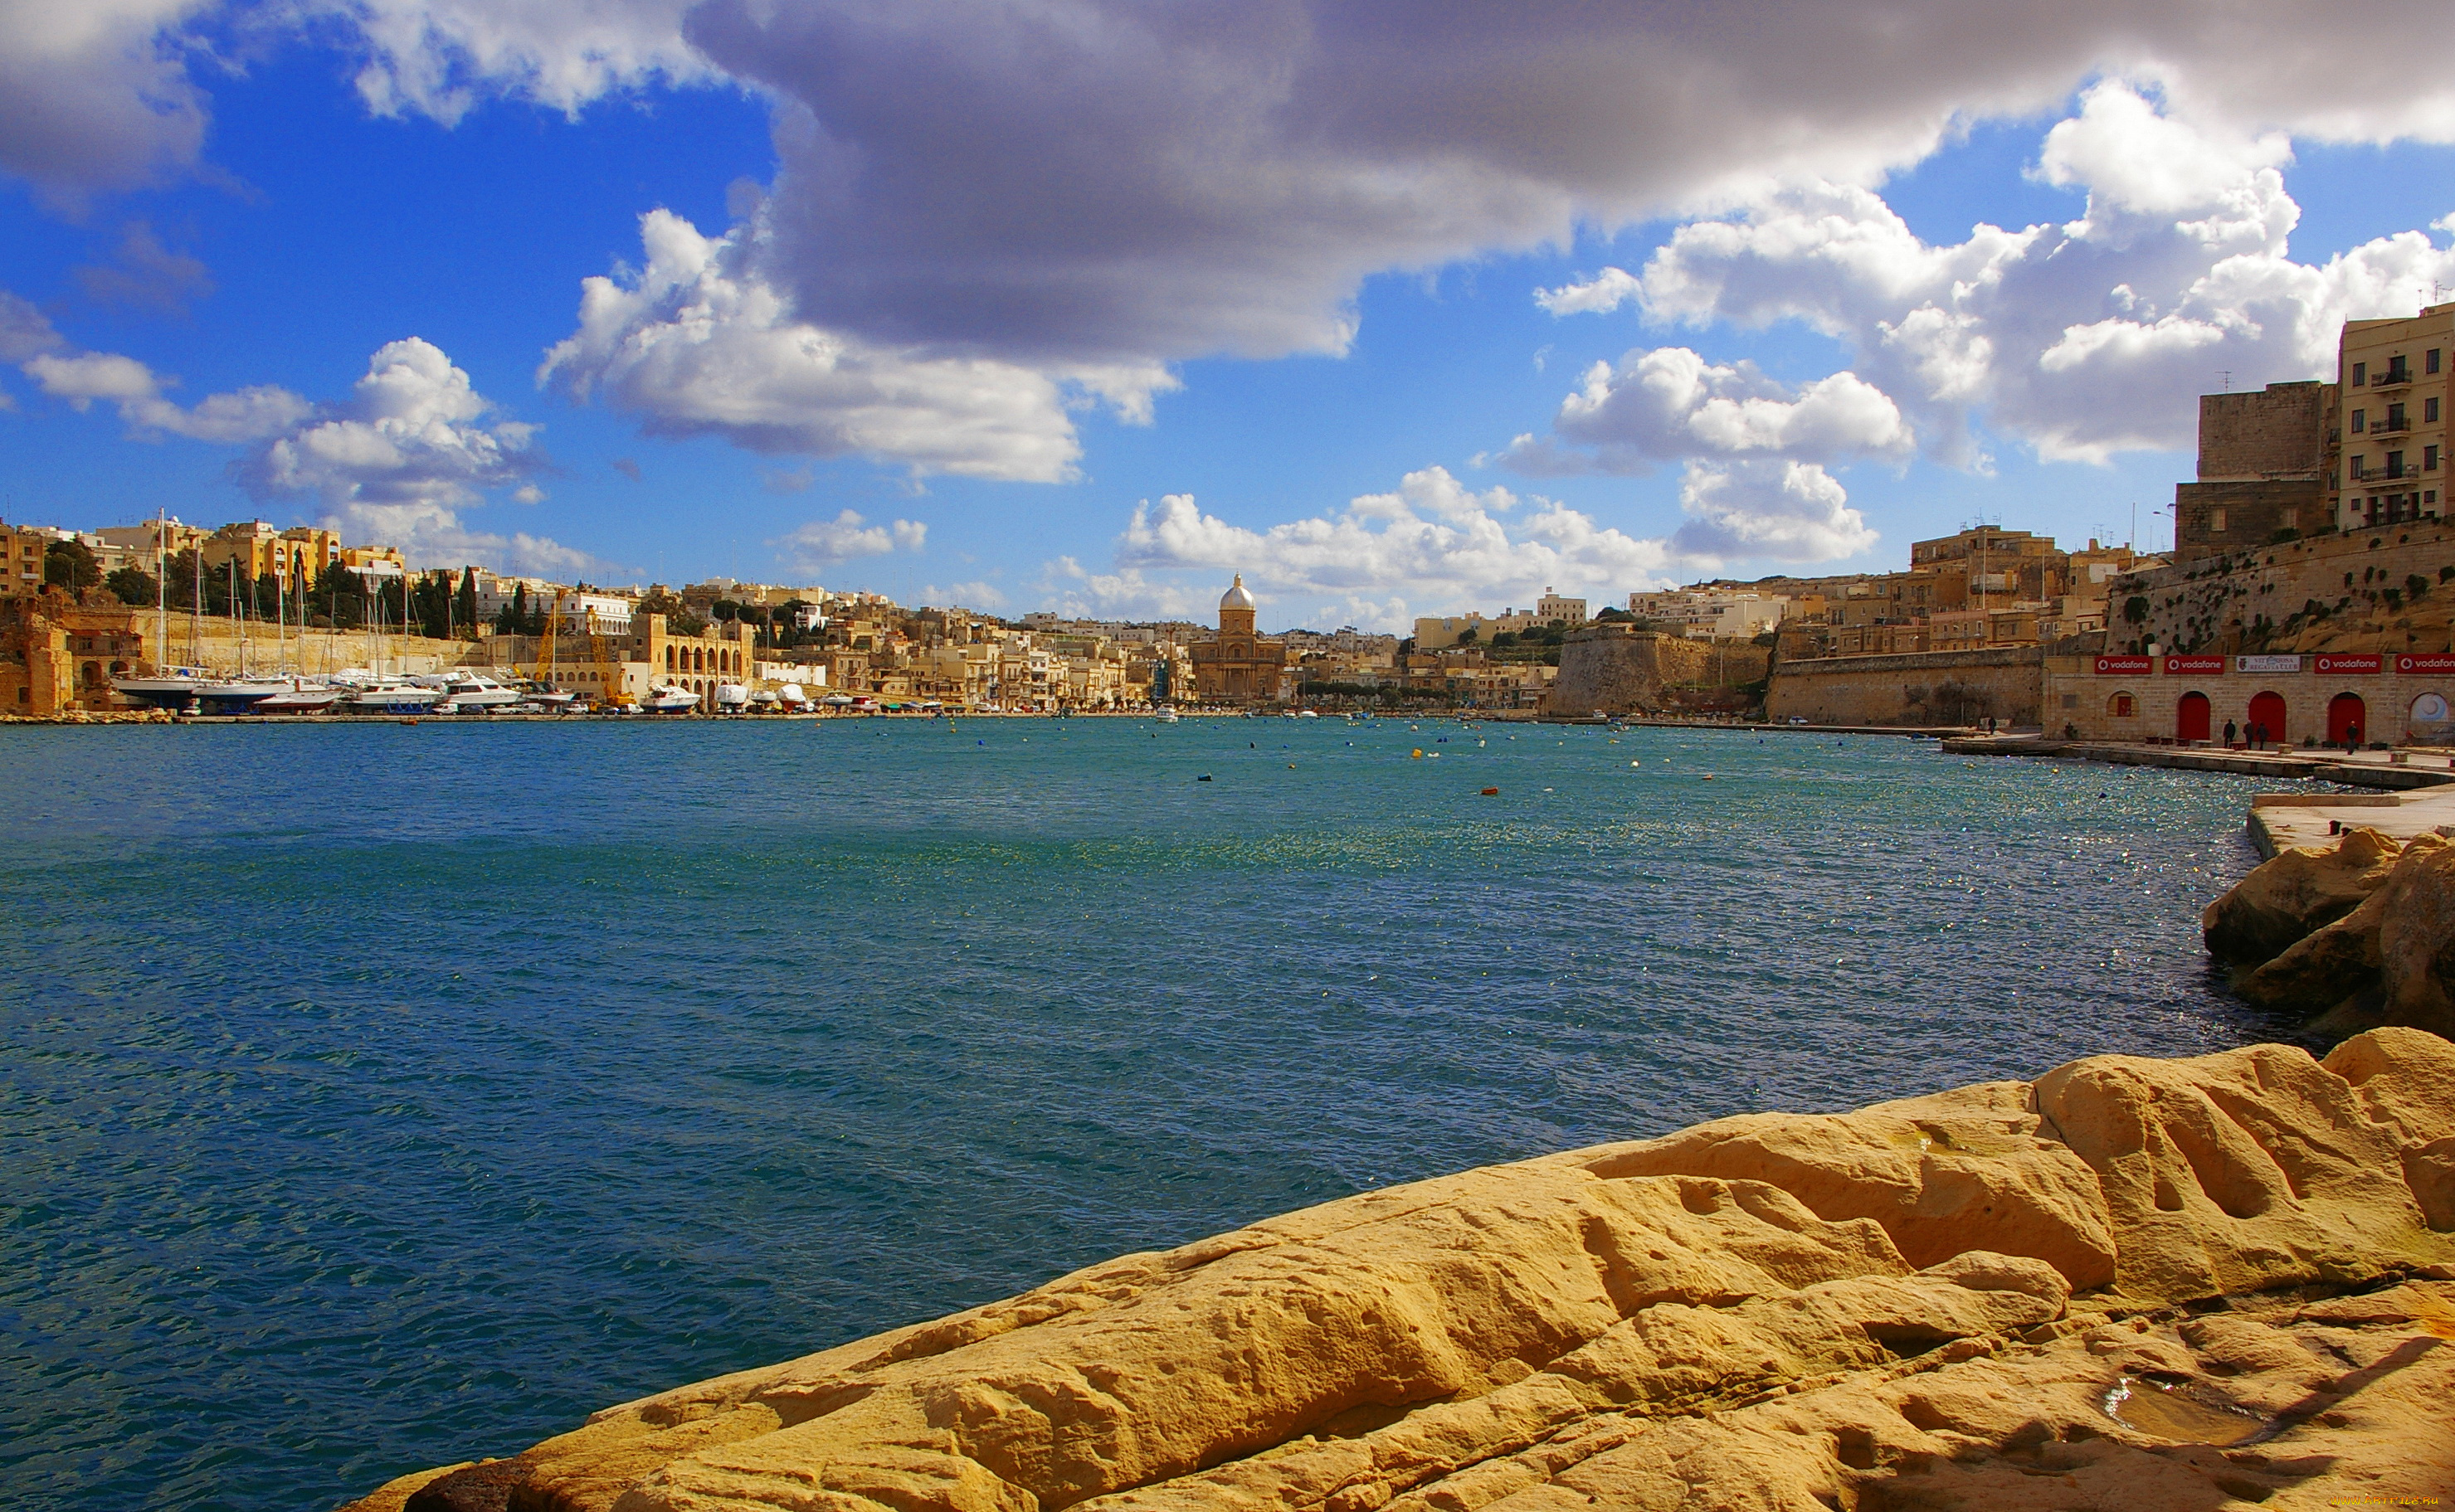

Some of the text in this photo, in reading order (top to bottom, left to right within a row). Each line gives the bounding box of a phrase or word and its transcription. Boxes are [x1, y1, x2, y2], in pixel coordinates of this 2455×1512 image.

[2110, 660, 2149, 668] vodafone
[2181, 660, 2221, 668] vodafone
[2332, 659, 2377, 668] vodafone
[2415, 659, 2455, 668] vodafon
